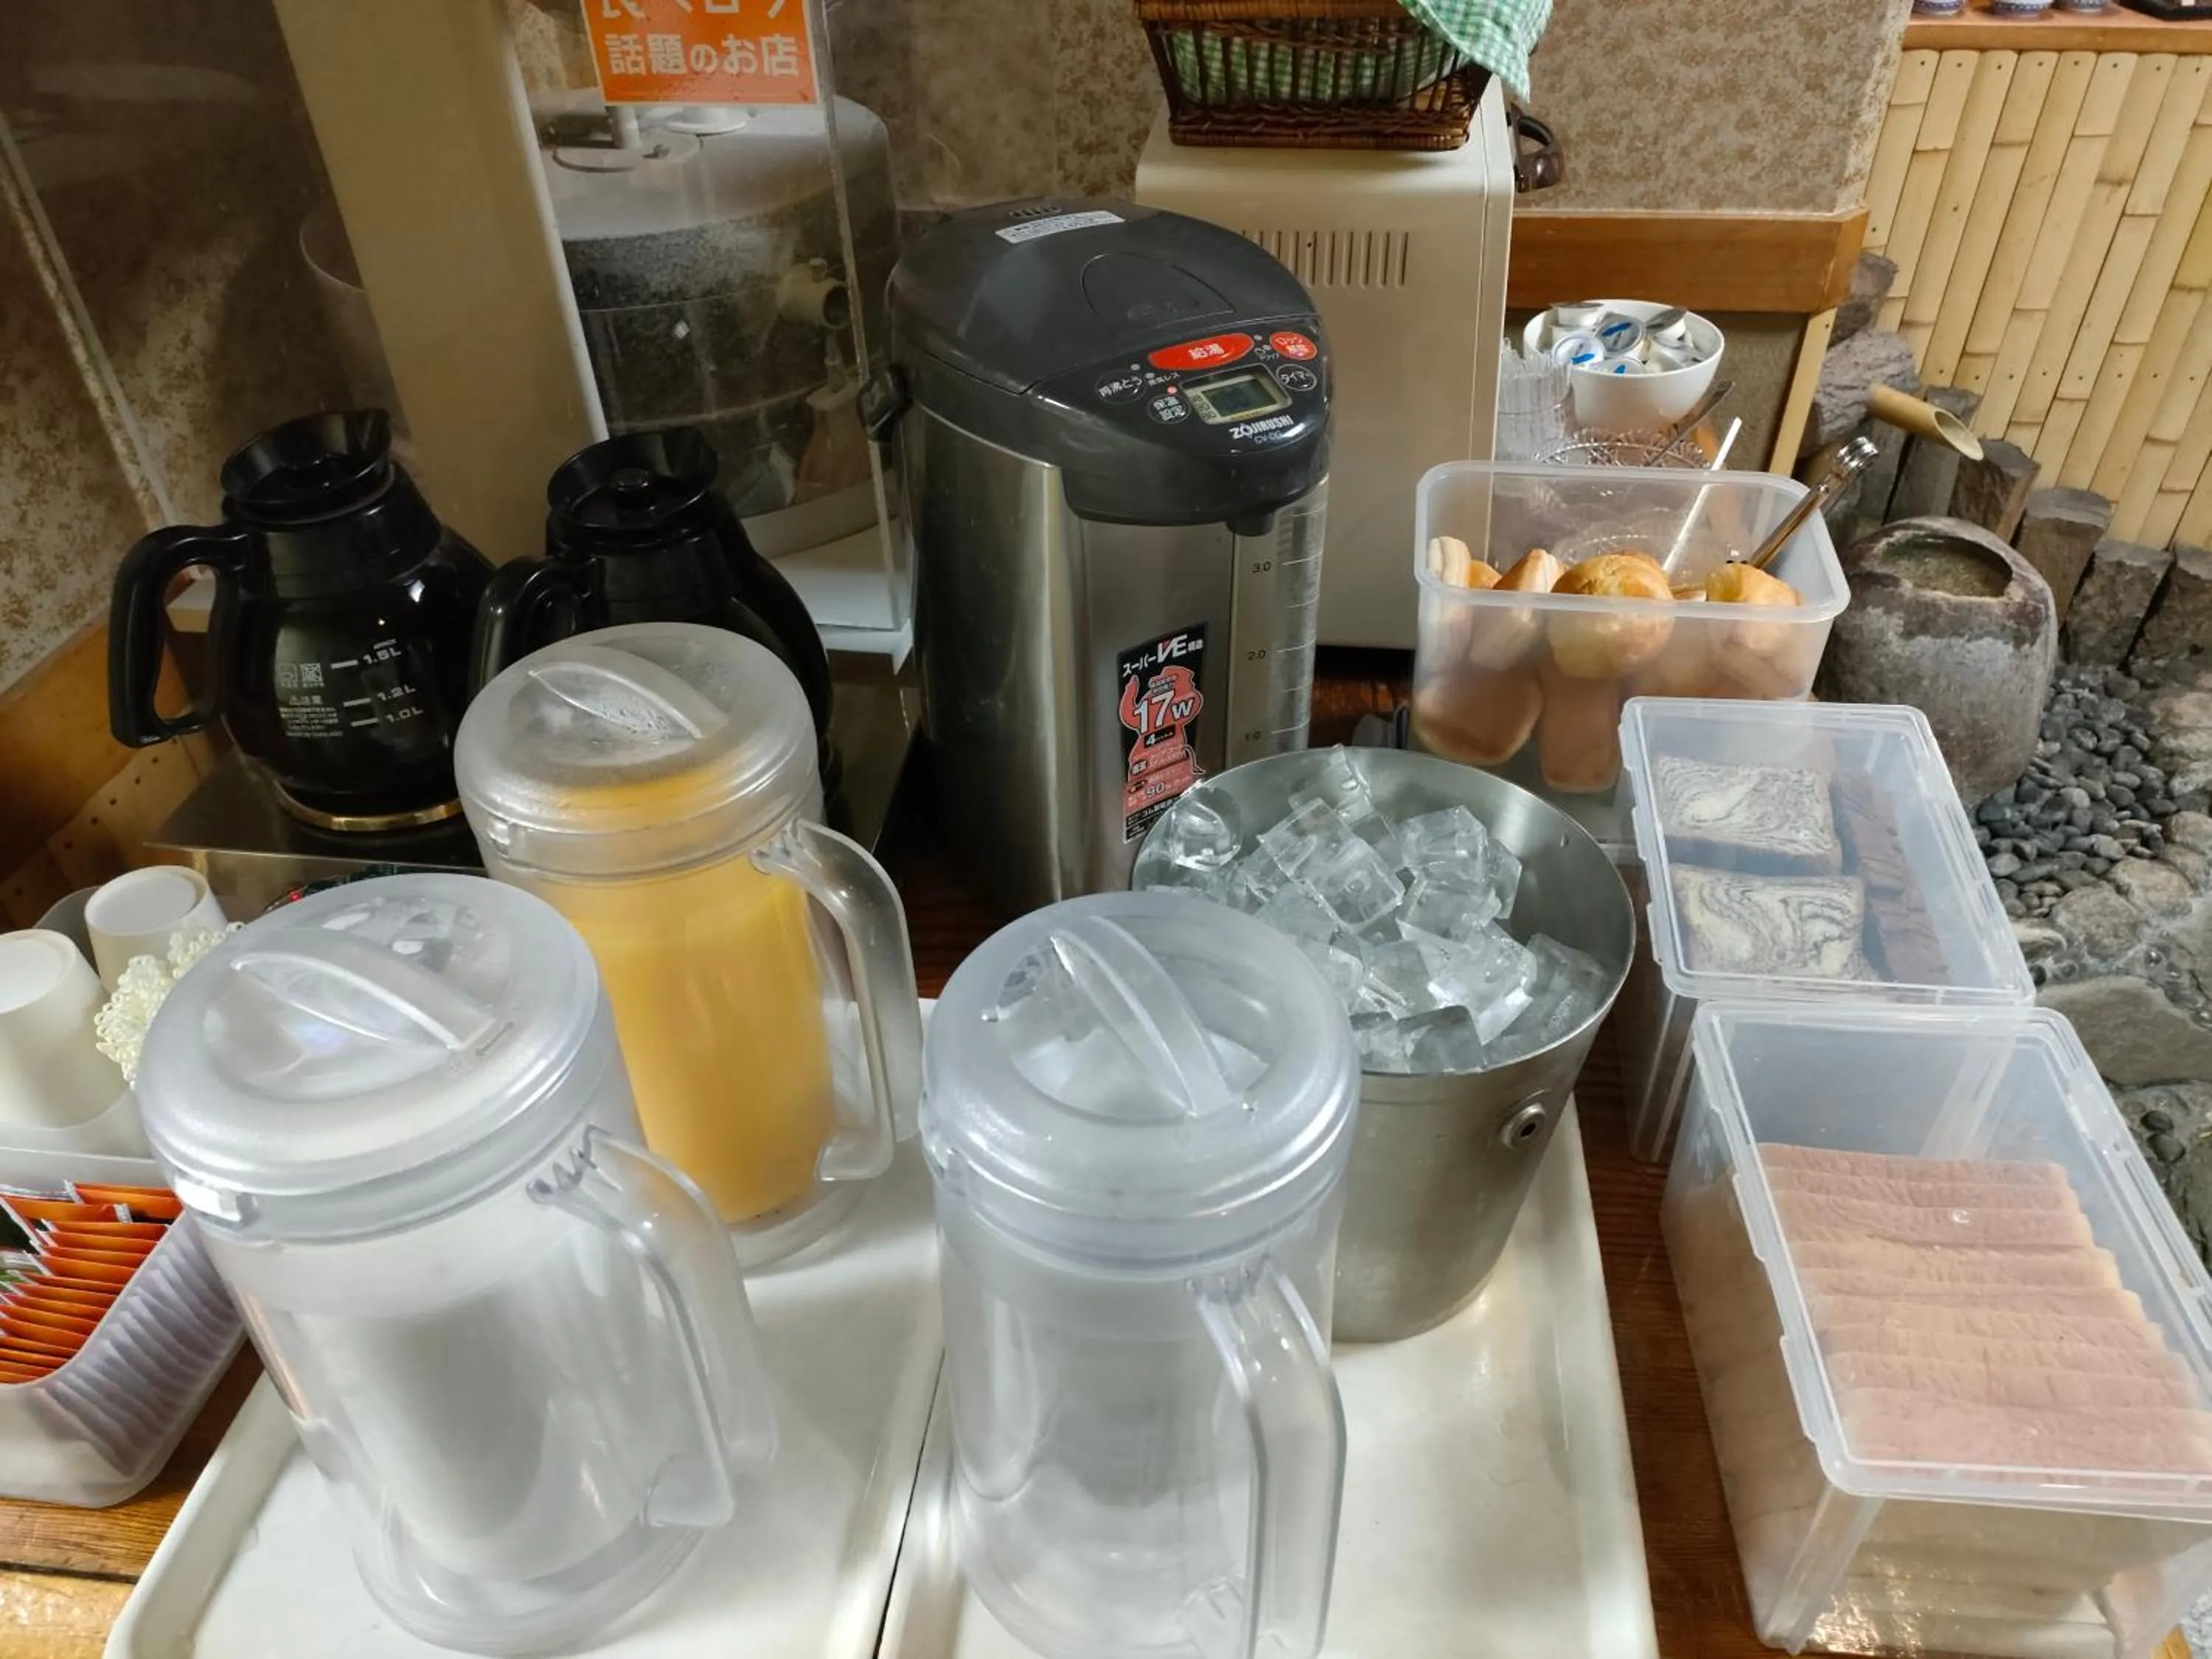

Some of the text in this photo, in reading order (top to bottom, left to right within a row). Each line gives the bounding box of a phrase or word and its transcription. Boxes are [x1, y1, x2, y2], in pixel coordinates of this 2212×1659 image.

[605, 34, 799, 76] 話題のお店
[1229, 414, 1294, 440] ZOJIRUSHI
[1253, 561, 1271, 573] 3.0
[364, 647, 402, 664] 1.5L
[1248, 650, 1266, 661] 2.0
[377, 684, 417, 700] 1.2L
[386, 707, 424, 723] 1.0L
[1133, 690, 1196, 733] 17W
